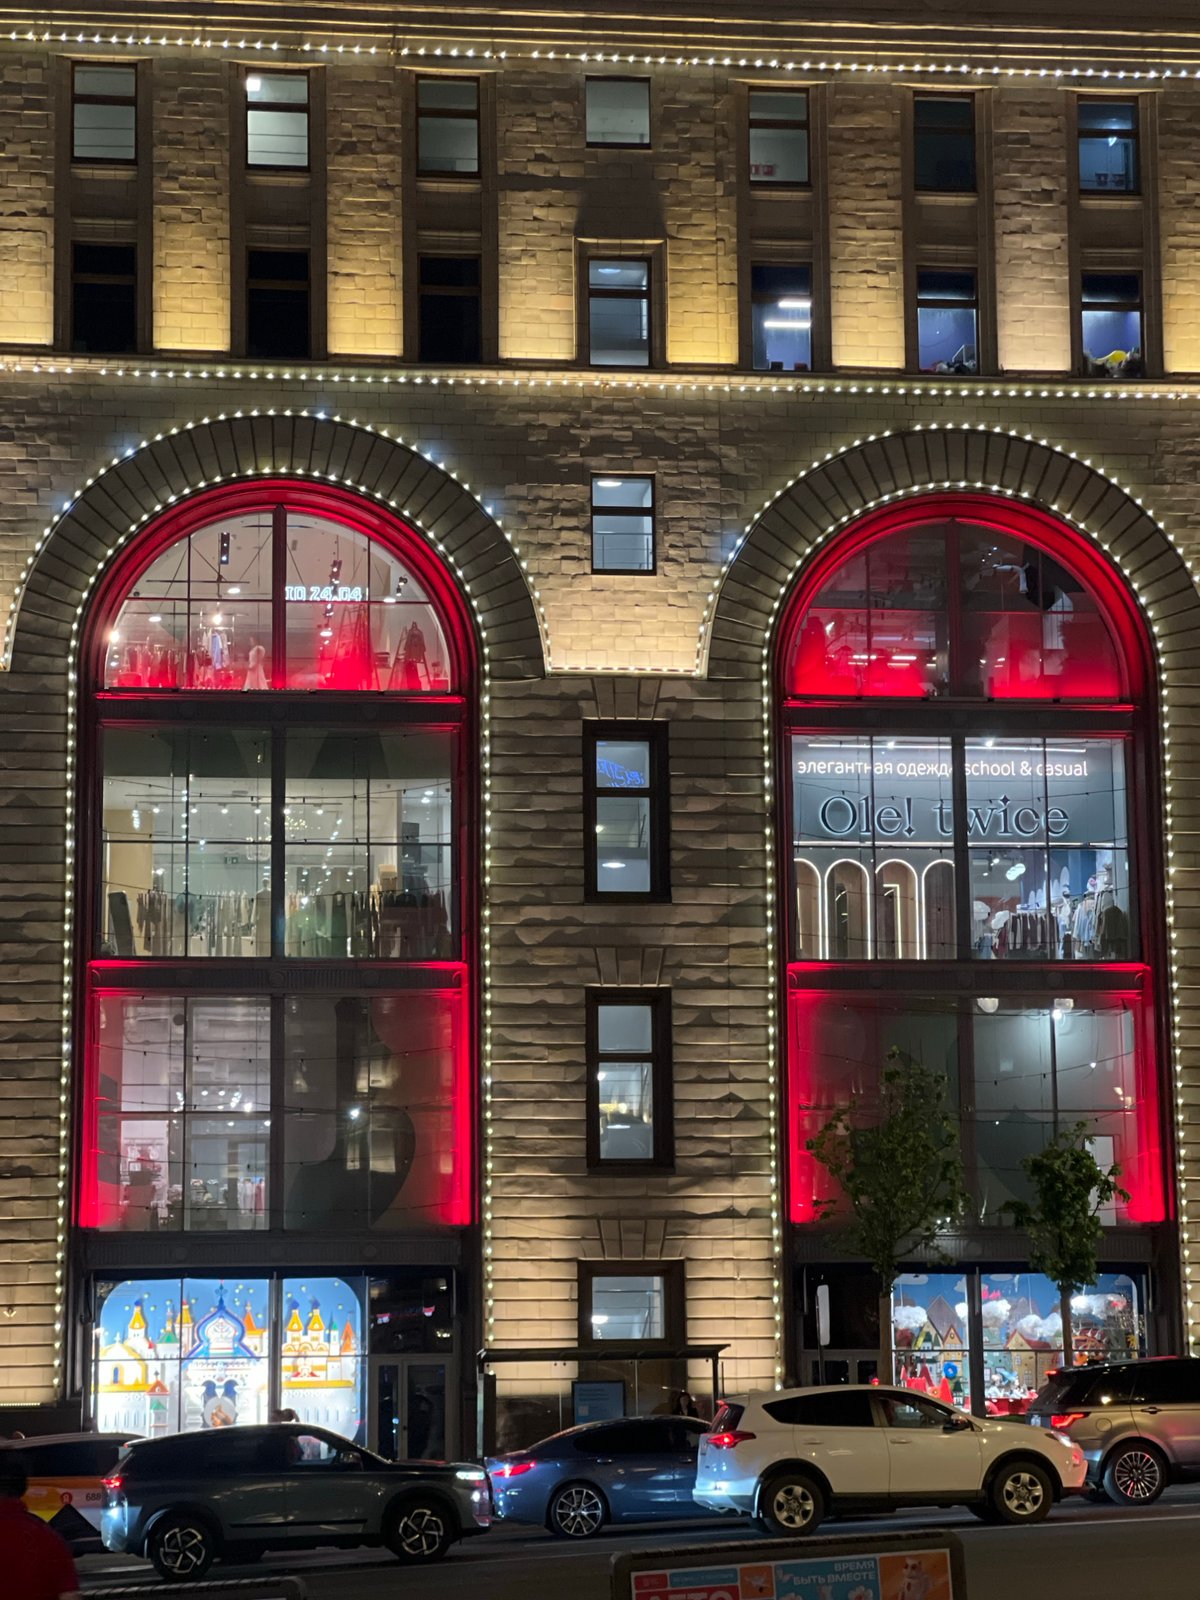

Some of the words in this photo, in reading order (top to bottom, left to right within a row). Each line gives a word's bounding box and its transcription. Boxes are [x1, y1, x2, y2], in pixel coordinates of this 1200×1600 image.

[310, 586, 362, 601] 24.04
[797, 761, 893, 775] элегантная
[897, 762, 953, 777] одежд
[965, 760, 1015, 776] school
[1020, 761, 1032, 776] &
[1036, 760, 1088, 776] casual
[819, 795, 915, 837] Ole!
[932, 794, 1070, 837] twice
[834, 1560, 875, 1572] ВРЕМЯ
[793, 1574, 826, 1585] БЫТЬ
